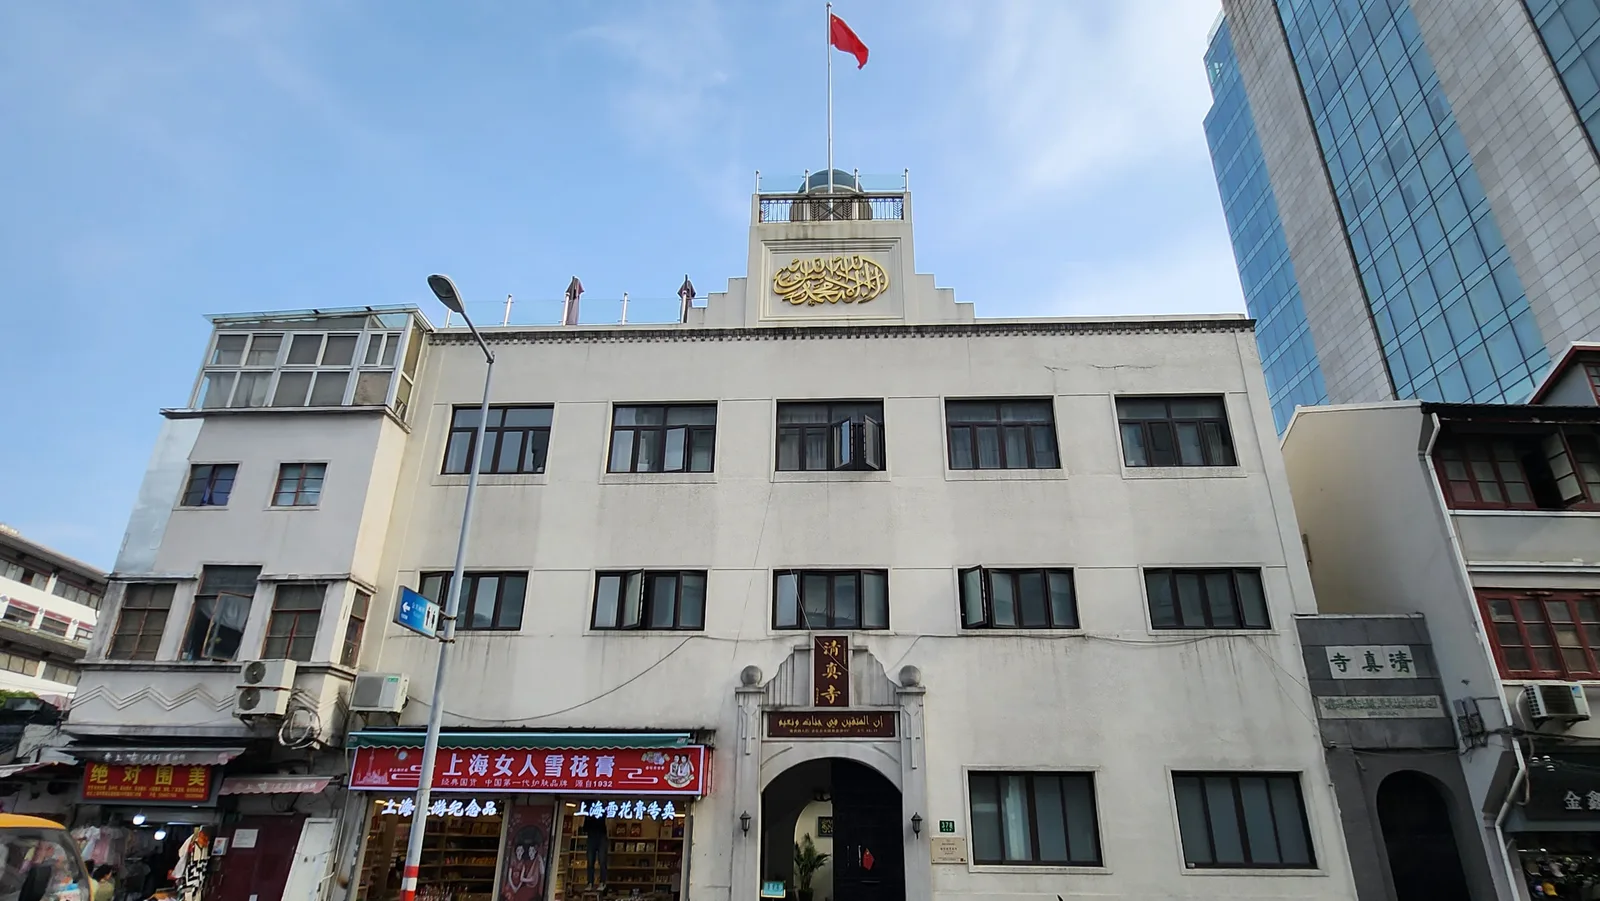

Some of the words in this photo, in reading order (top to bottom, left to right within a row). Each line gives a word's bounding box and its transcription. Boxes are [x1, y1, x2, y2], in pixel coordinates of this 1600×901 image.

[820, 640, 841, 704] 清真寺
[1330, 650, 1412, 673] 清真寺
[442, 752, 616, 778] 上海女人雪花膏
[441, 778, 477, 788] 经典国货
[485, 778, 568, 788] 中国第一代护肤品牌
[575, 779, 613, 788] 源自1932
[381, 798, 497, 817] 上海游纪念品
[573, 800, 676, 820] 上海雪花膏专卖
